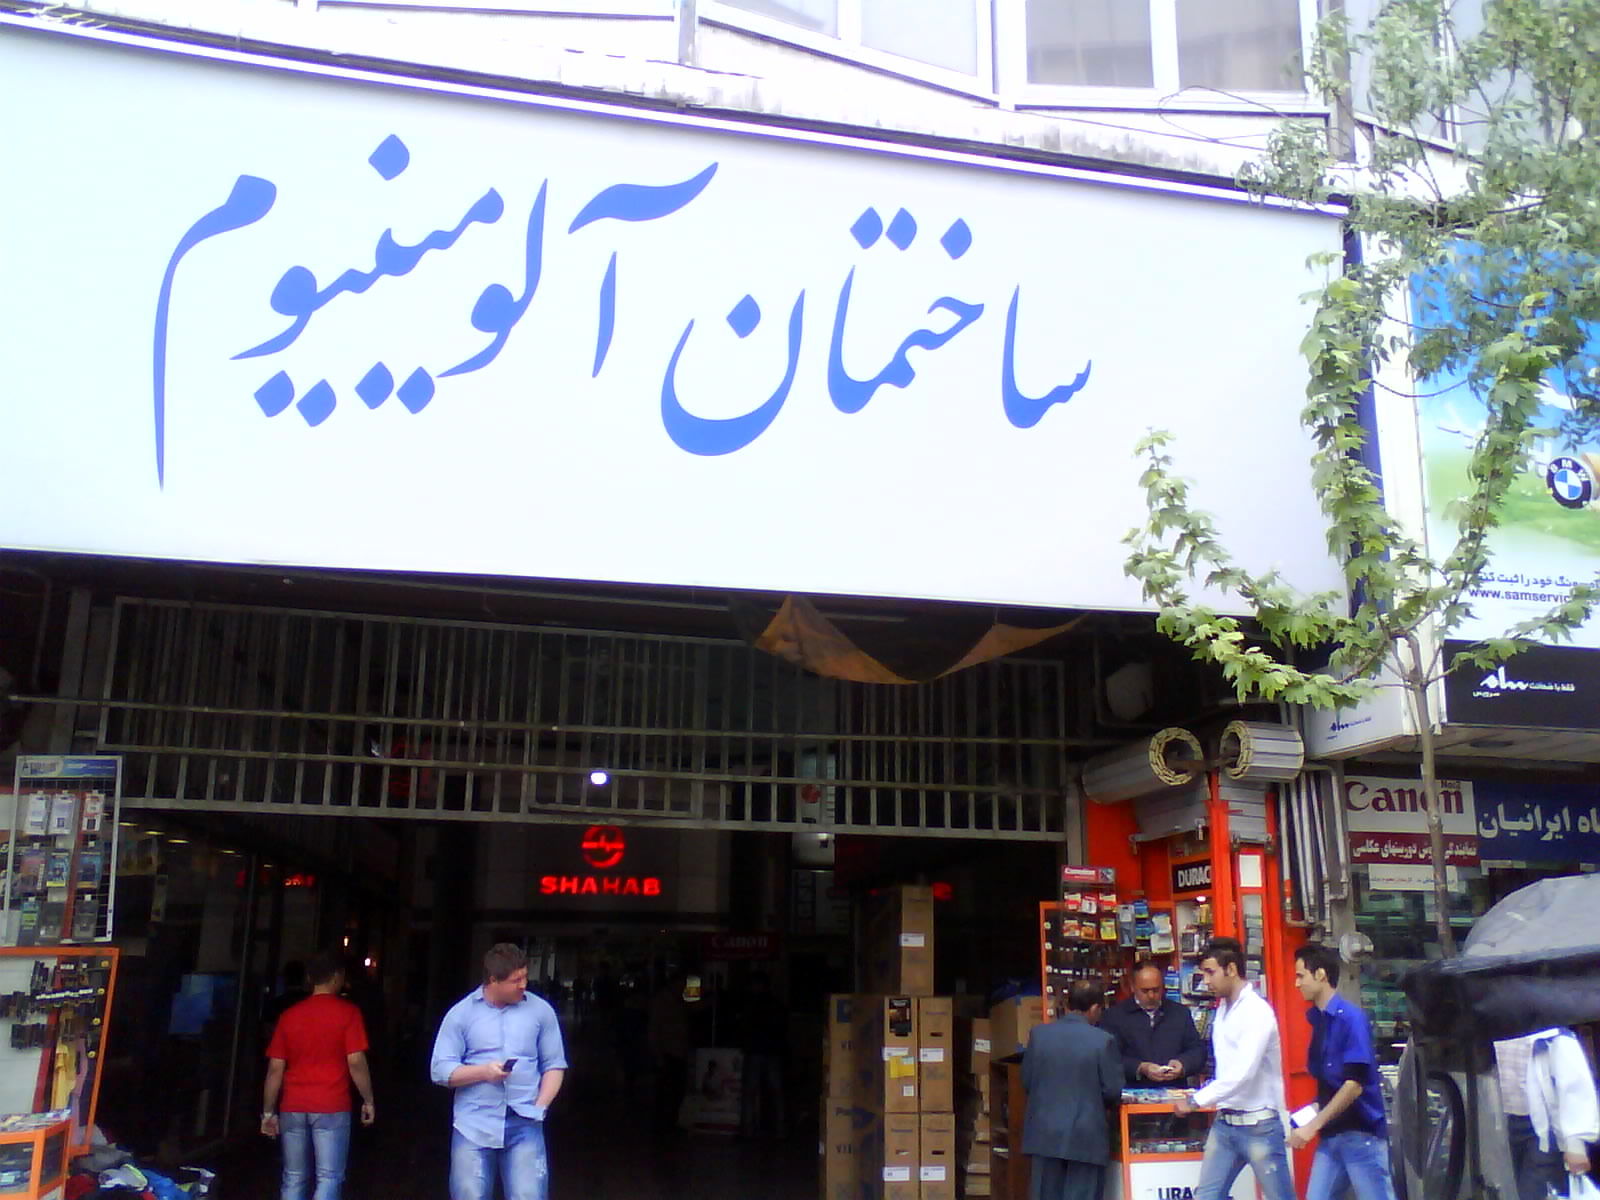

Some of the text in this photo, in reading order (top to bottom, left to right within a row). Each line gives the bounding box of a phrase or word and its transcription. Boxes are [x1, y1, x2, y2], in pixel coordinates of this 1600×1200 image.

[152, 133, 1092, 491] ساختمان آلومینیوم
[1467, 588, 1574, 604] www.samservic
[1344, 780, 1464, 814] Canon
[1479, 801, 1571, 841] ایرانیان
[540, 876, 662, 897] SHAHAB
